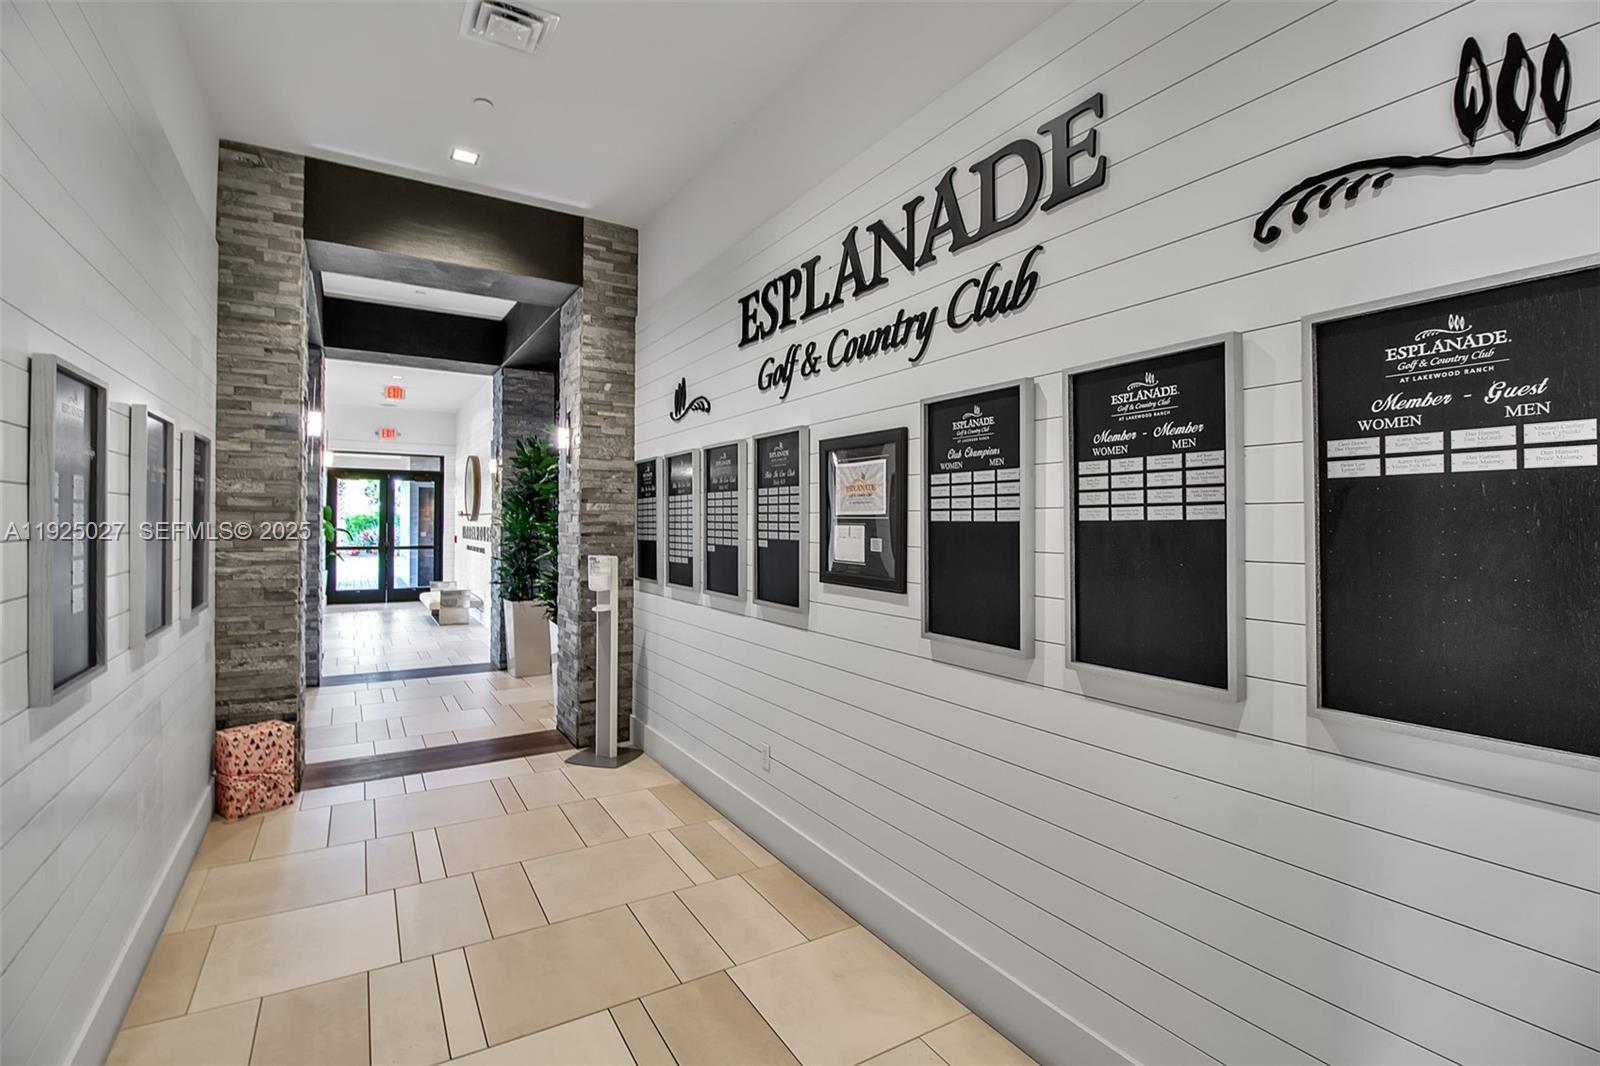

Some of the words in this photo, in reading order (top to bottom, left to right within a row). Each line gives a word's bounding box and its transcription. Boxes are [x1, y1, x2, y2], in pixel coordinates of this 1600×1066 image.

[738, 92, 1107, 348] ESPLANADE
[757, 343, 801, 400] Golf
[800, 342, 822, 376] &
[826, 307, 938, 363] Country
[946, 244, 1044, 329] Club
[1397, 359, 1418, 372] Golf
[1418, 359, 1428, 368] &
[1430, 352, 1470, 368] Country
[1471, 347, 1495, 361] Club
[1412, 370, 1461, 382] LAKEWOOD
[1464, 365, 1495, 375] RANCH
[387, 386, 403, 399] EXIT
[1371, 391, 1453, 413] Member
[1484, 377, 1549, 405] Guest
[1117, 404, 1128, 413] Golf
[1135, 401, 1157, 410] Country
[1157, 397, 1171, 406] Club
[1504, 401, 1552, 418] MEN
[1357, 414, 1423, 432] WOMEN
[382, 429, 395, 438] EXIT
[1093, 429, 1137, 444] Member
[1153, 421, 1204, 438] Member
[1092, 445, 1129, 457] WOMEN
[1171, 437, 1197, 449] MEN
[940, 461, 963, 470] WOMEN
[989, 457, 1005, 466] MEN
